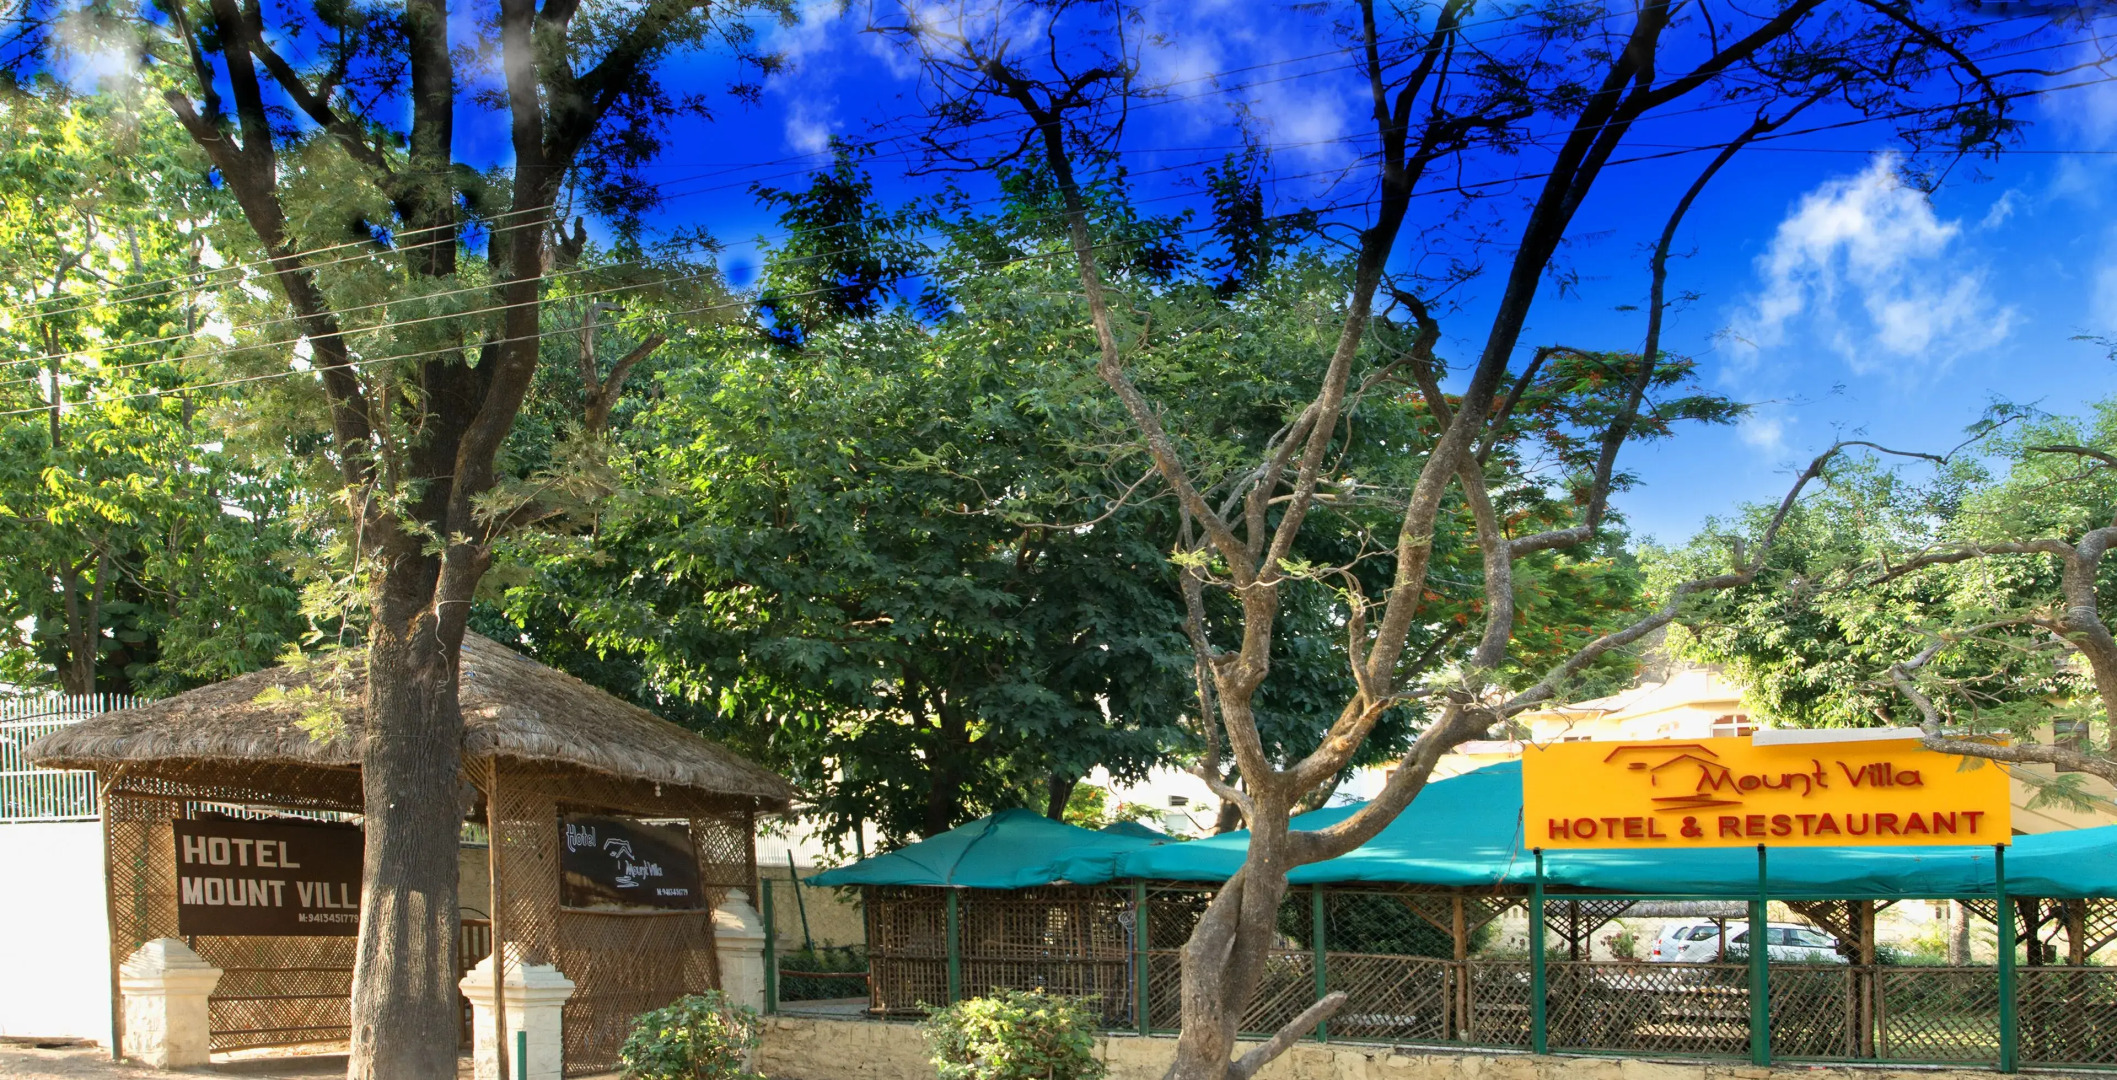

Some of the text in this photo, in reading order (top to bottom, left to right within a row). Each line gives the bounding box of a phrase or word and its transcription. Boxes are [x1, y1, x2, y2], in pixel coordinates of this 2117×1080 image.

[1696, 759, 1925, 798] Mount Villa
[566, 823, 597, 853] Hotel
[1548, 811, 1985, 840] HOTEL & RESTAURANT
[182, 834, 301, 869] HOTEL
[625, 859, 649, 881] Mount
[181, 876, 359, 909] MOUNT VILL
